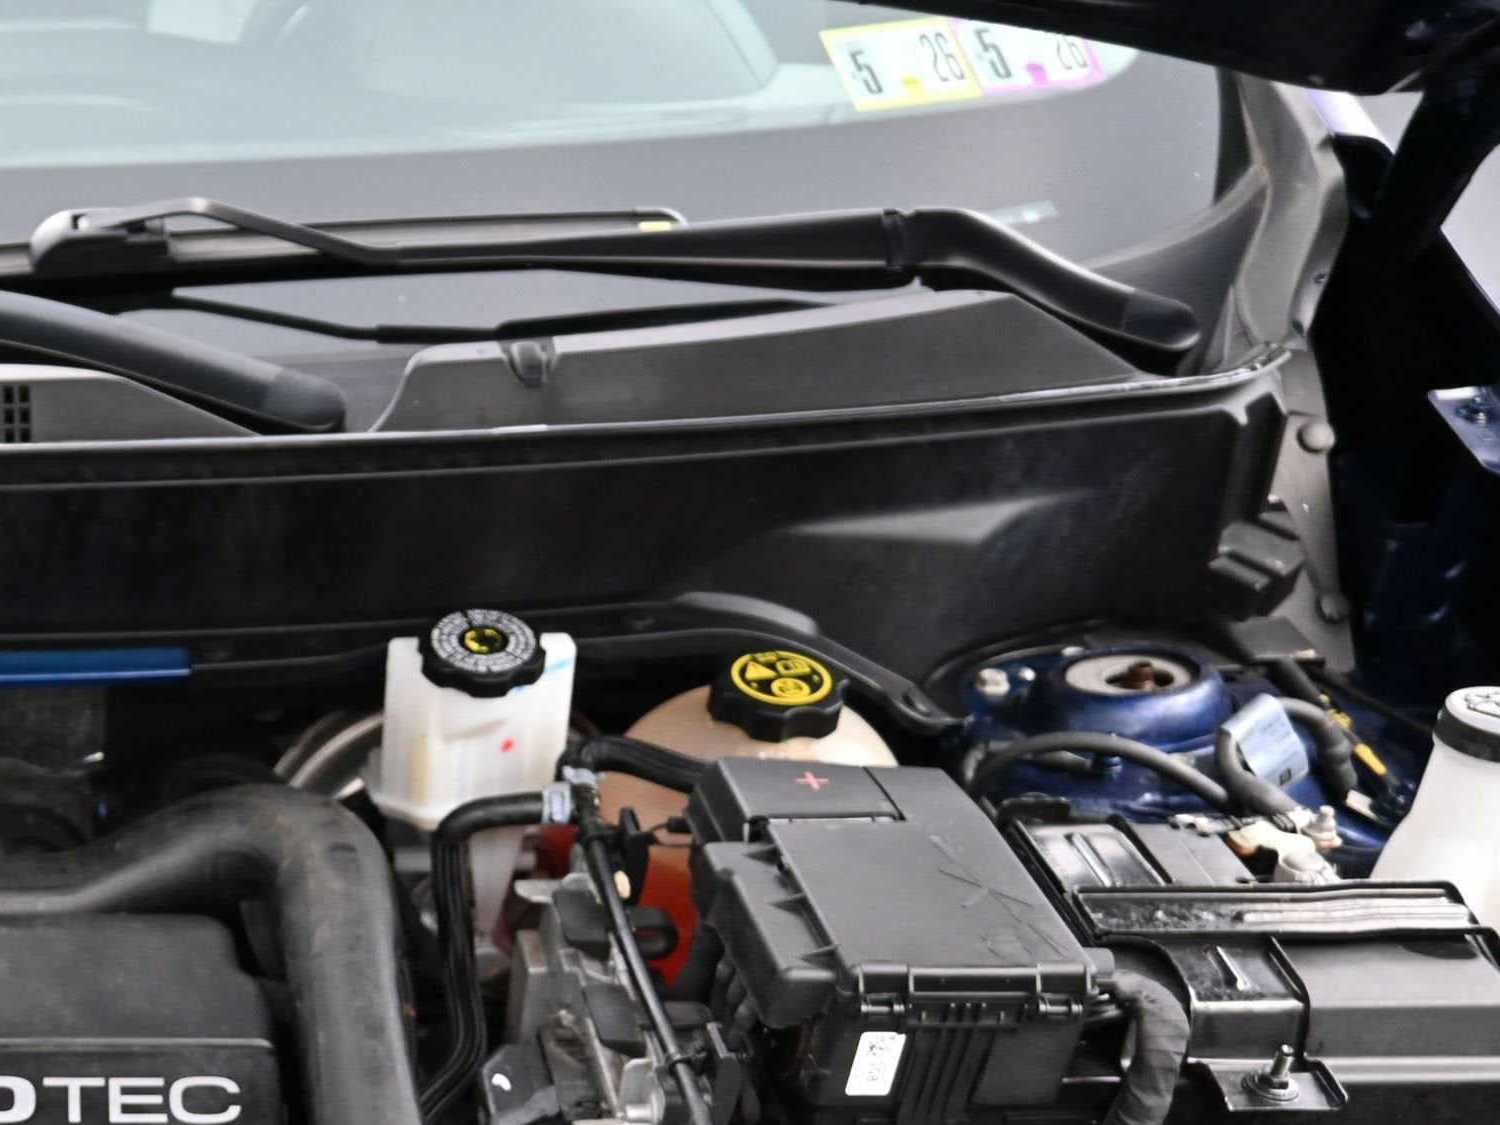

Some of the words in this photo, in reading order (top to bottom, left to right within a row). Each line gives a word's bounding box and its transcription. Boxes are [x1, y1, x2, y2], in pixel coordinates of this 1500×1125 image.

[849, 48, 884, 96] 5
[918, 31, 966, 84] 26
[973, 27, 1013, 80] 5
[1054, 33, 1089, 71] 26
